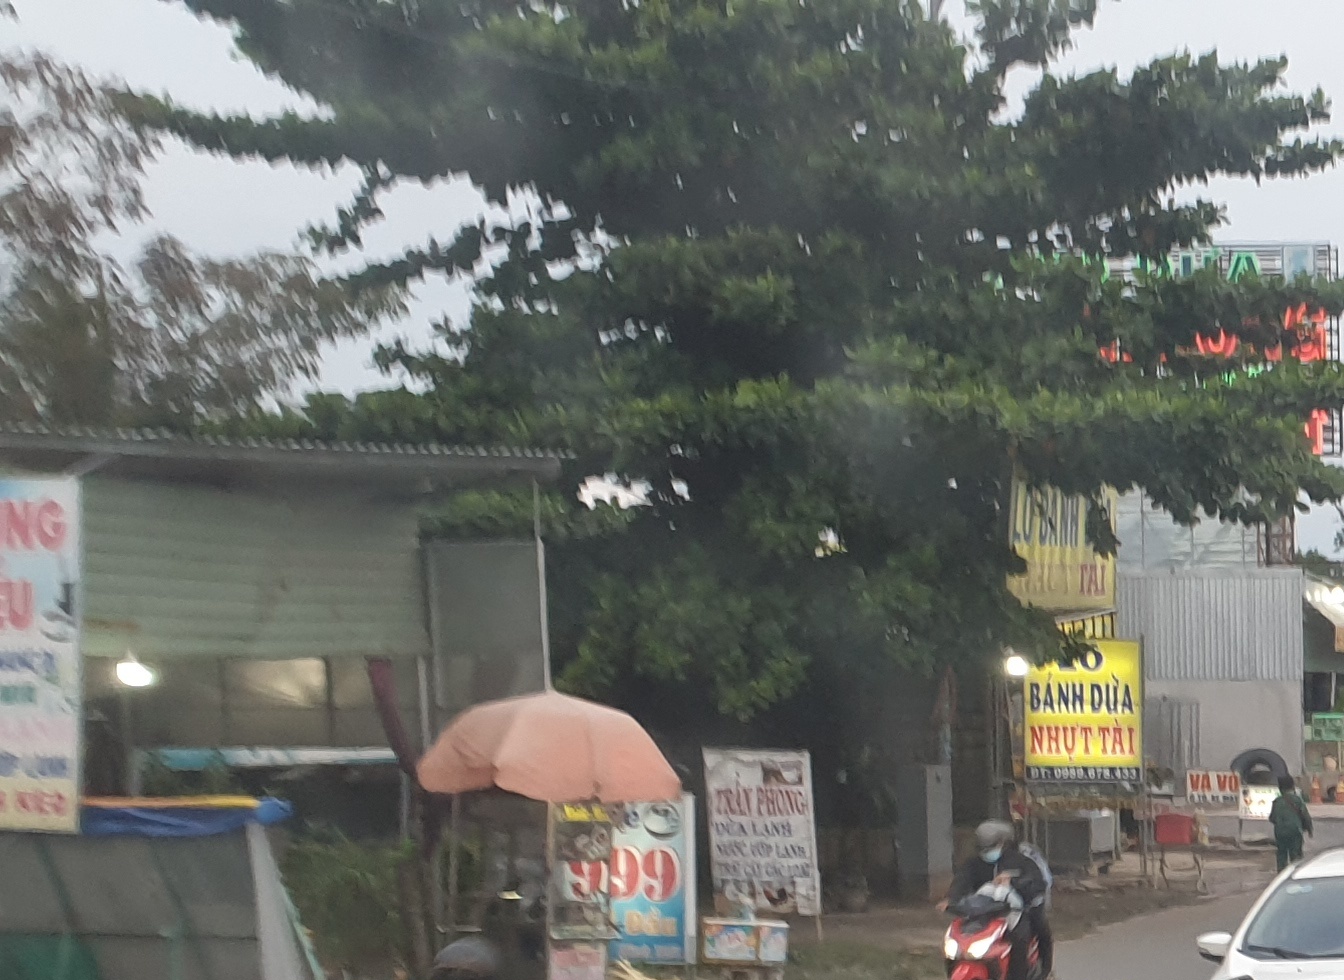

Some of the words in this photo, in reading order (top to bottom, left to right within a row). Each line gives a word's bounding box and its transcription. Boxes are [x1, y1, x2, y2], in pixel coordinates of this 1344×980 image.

[1029, 672, 1085, 714] BÁNH
[1090, 672, 1135, 714] DỪA
[1098, 718, 1136, 756] TÀI
